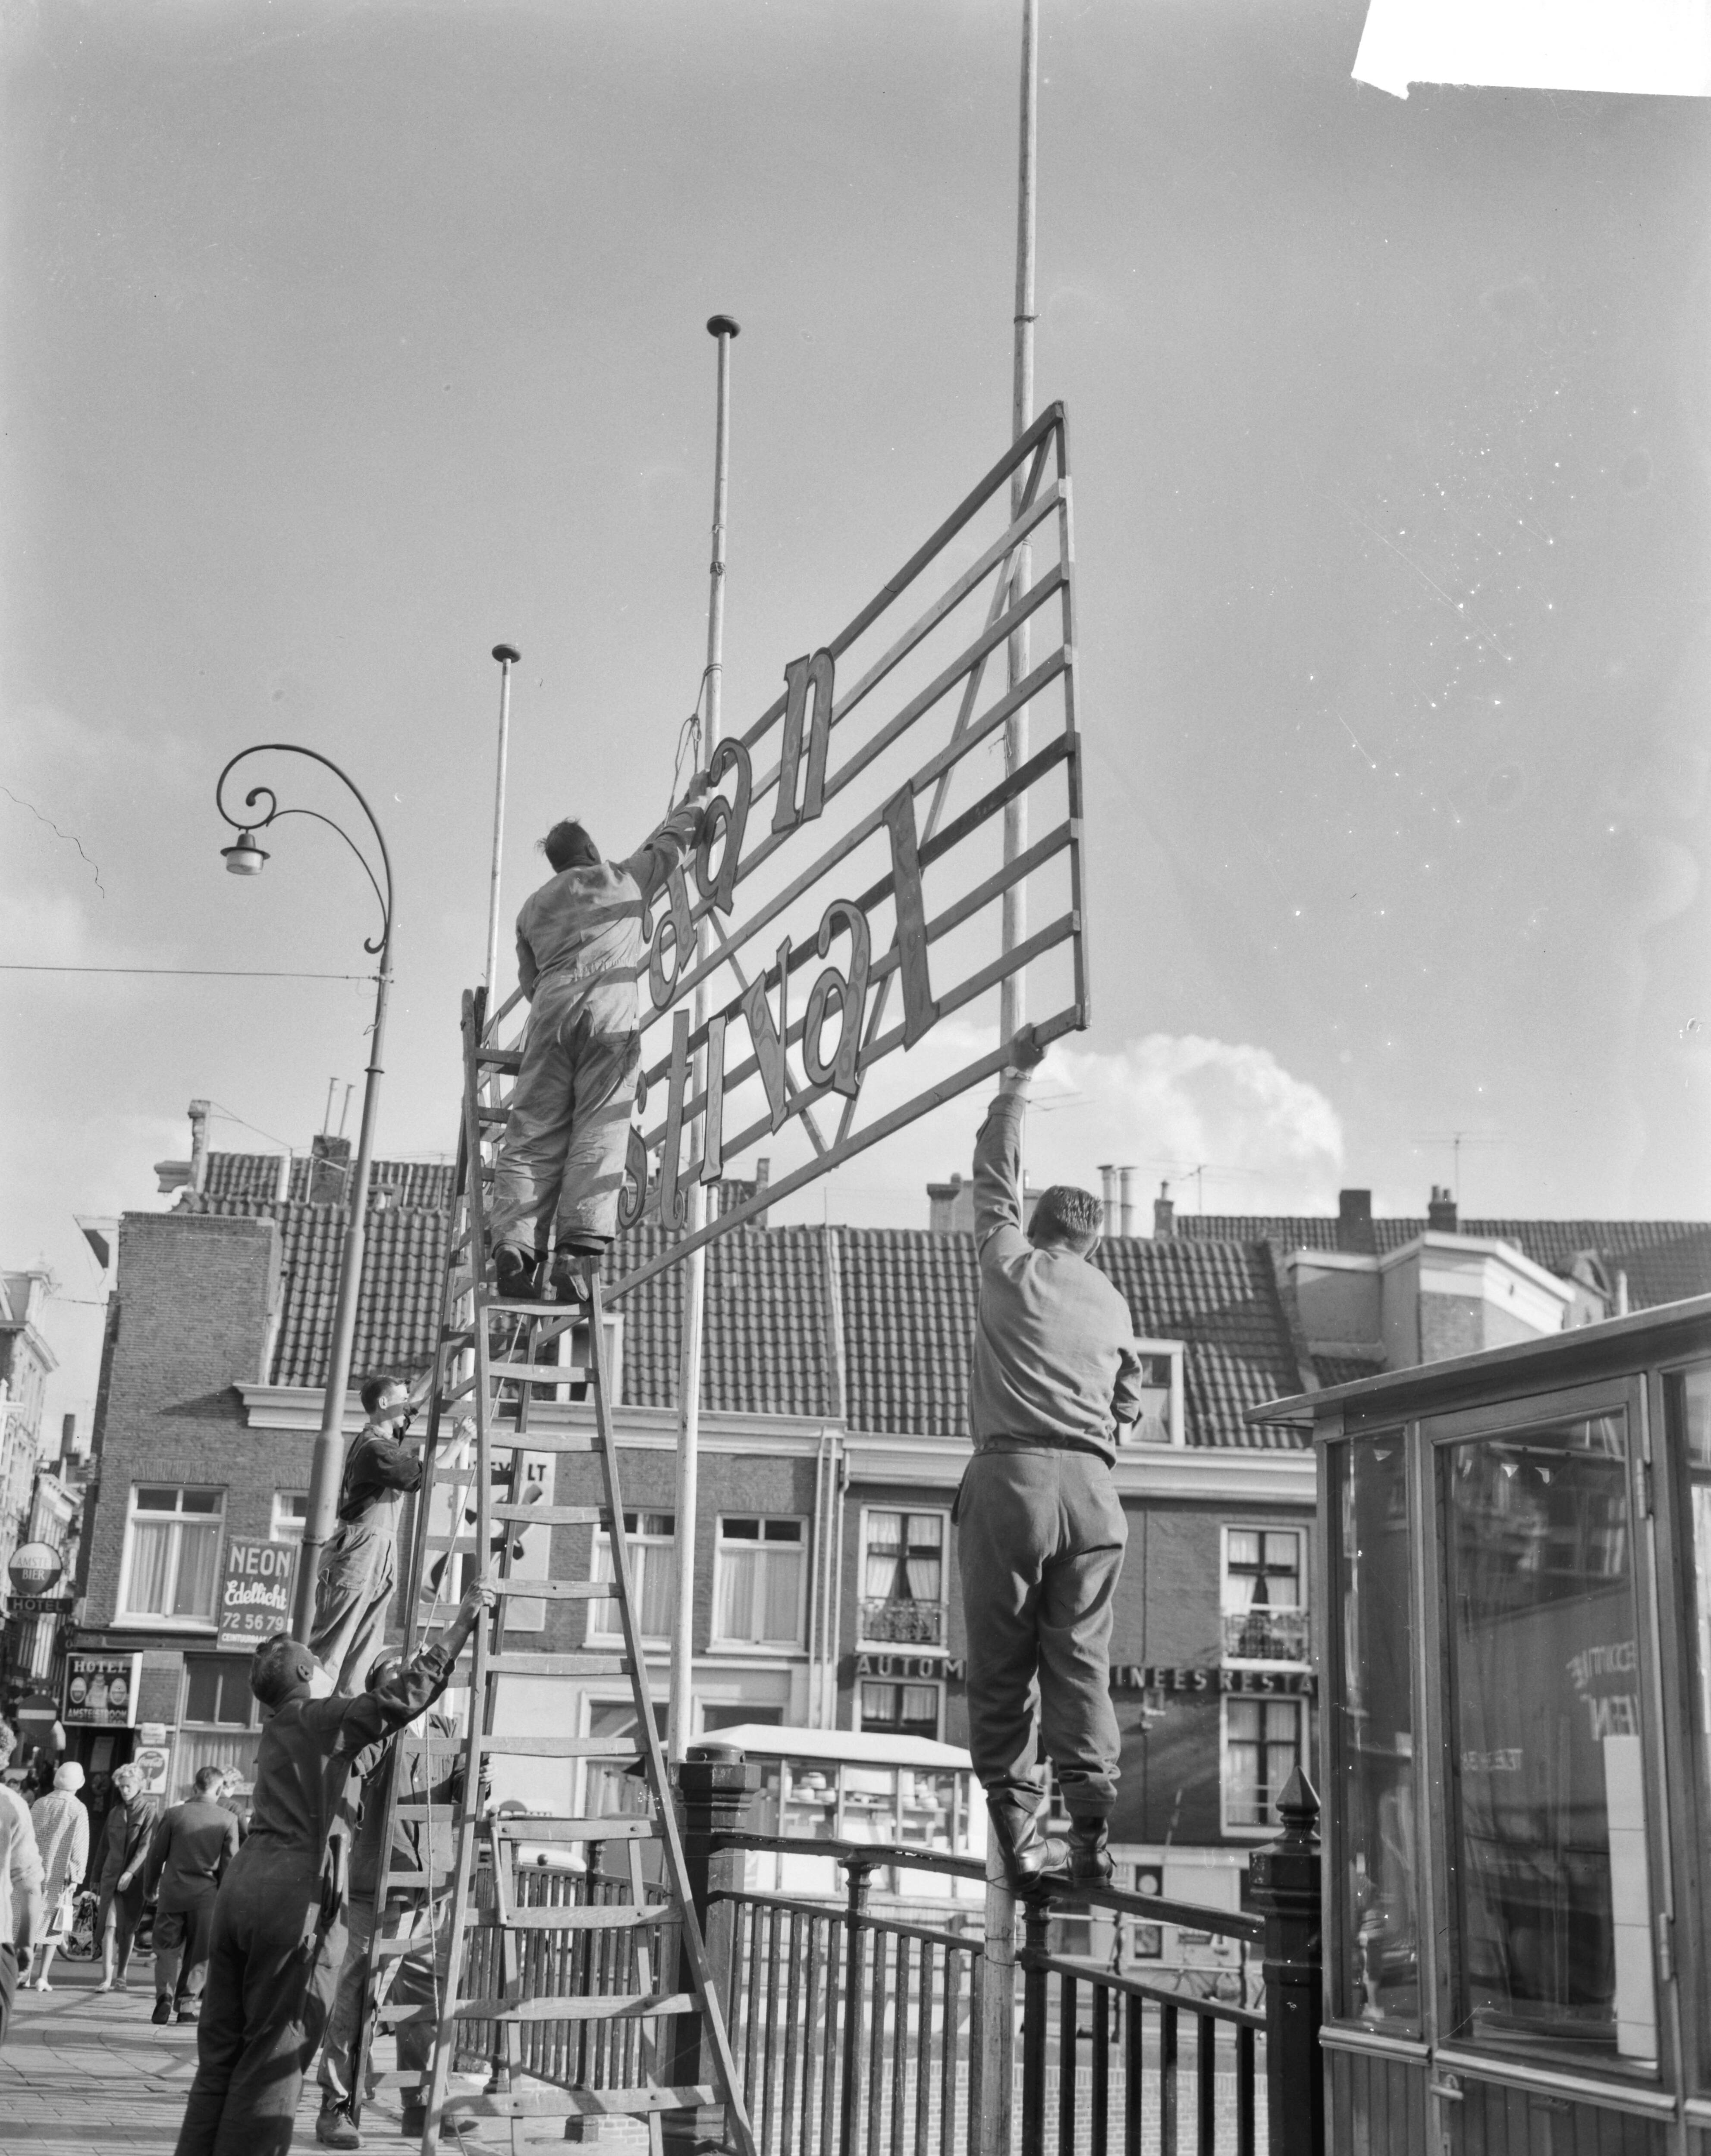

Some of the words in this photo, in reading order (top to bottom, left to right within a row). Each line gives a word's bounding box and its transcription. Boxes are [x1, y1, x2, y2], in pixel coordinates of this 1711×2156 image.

[229, 1545, 291, 1577] NEON
[22, 1569, 45, 1580] BIER
[224, 1580, 287, 1611] Edellicht
[13, 1599, 63, 1611] HOTEL
[223, 1612, 241, 1628] 72
[245, 1614, 264, 1630] 56
[266, 1616, 284, 1632] 79
[74, 1661, 127, 1673] HOTEL
